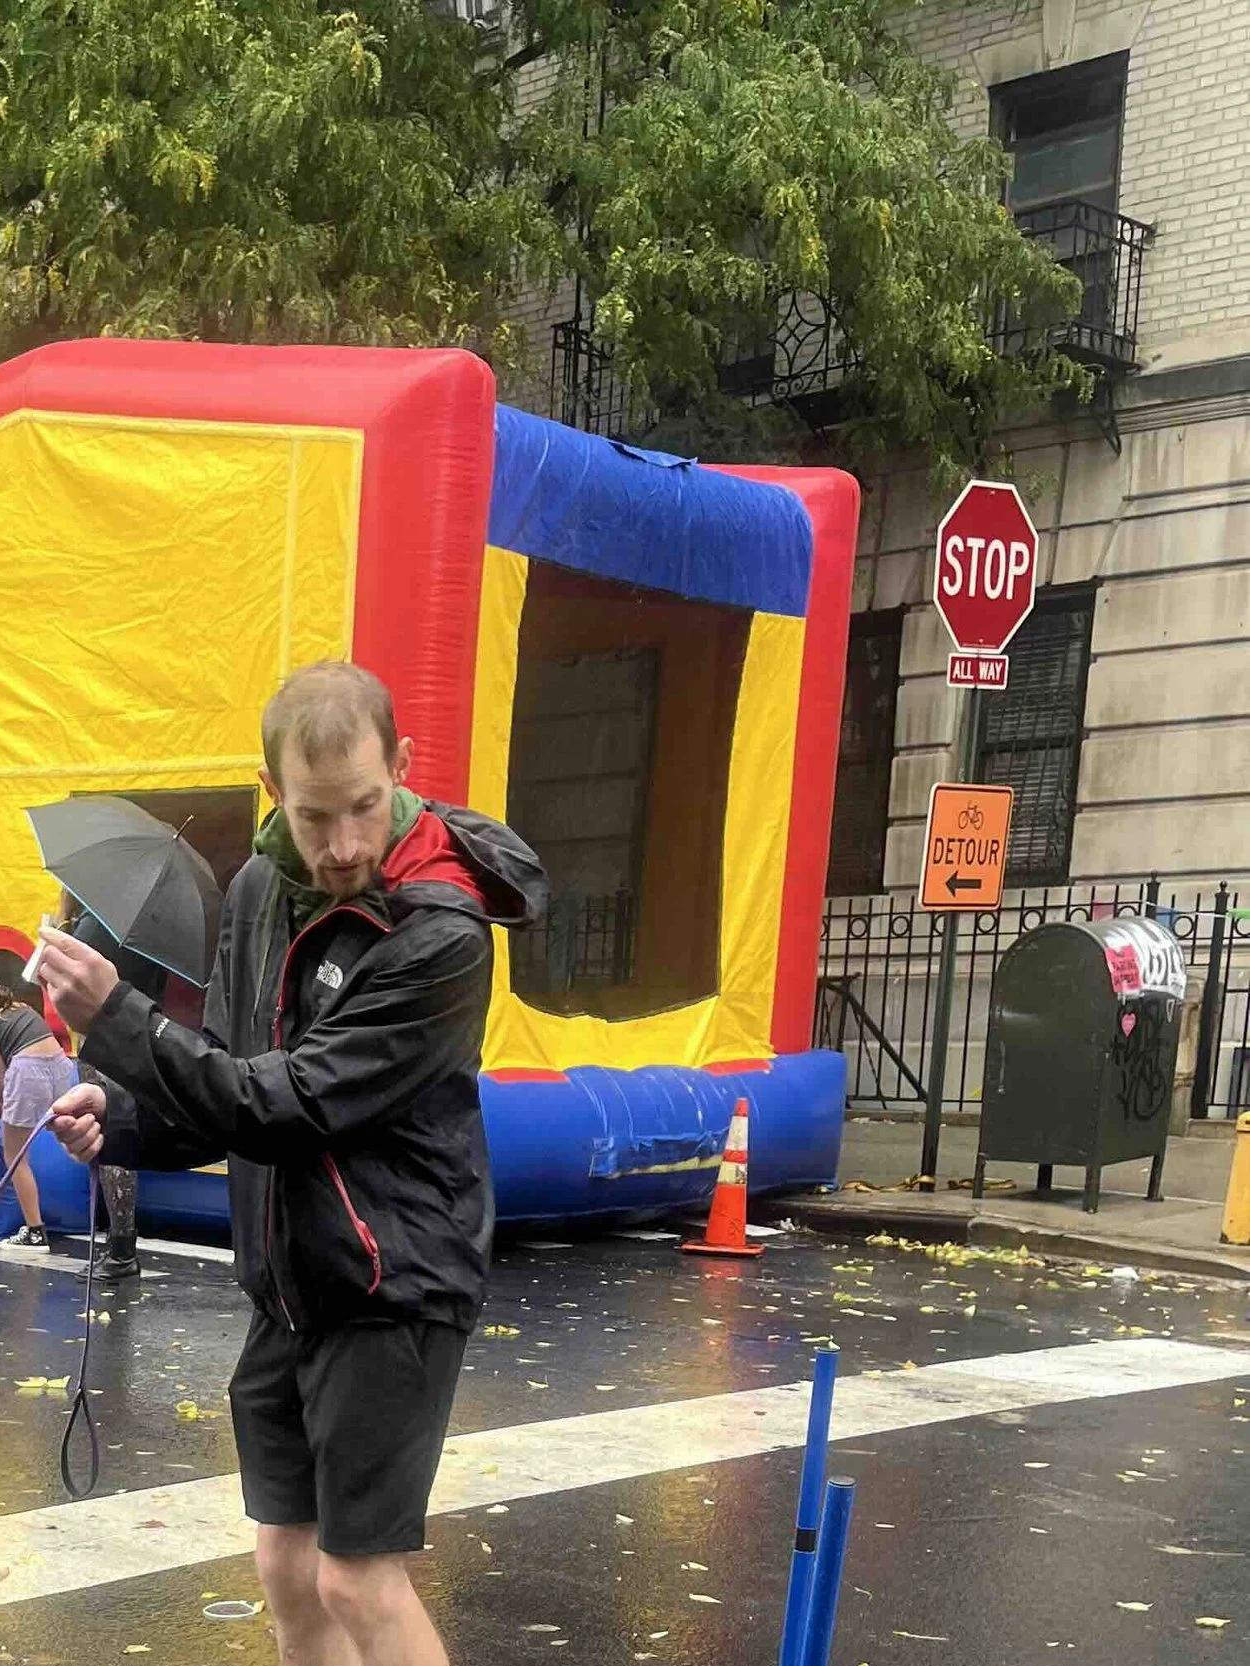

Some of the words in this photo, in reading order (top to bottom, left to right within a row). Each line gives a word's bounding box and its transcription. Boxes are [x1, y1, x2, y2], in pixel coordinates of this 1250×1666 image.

[942, 535, 1030, 600] STOP
[952, 660, 974, 679] ALL
[978, 661, 1003, 680] WAY
[933, 838, 999, 865] DETOUR
